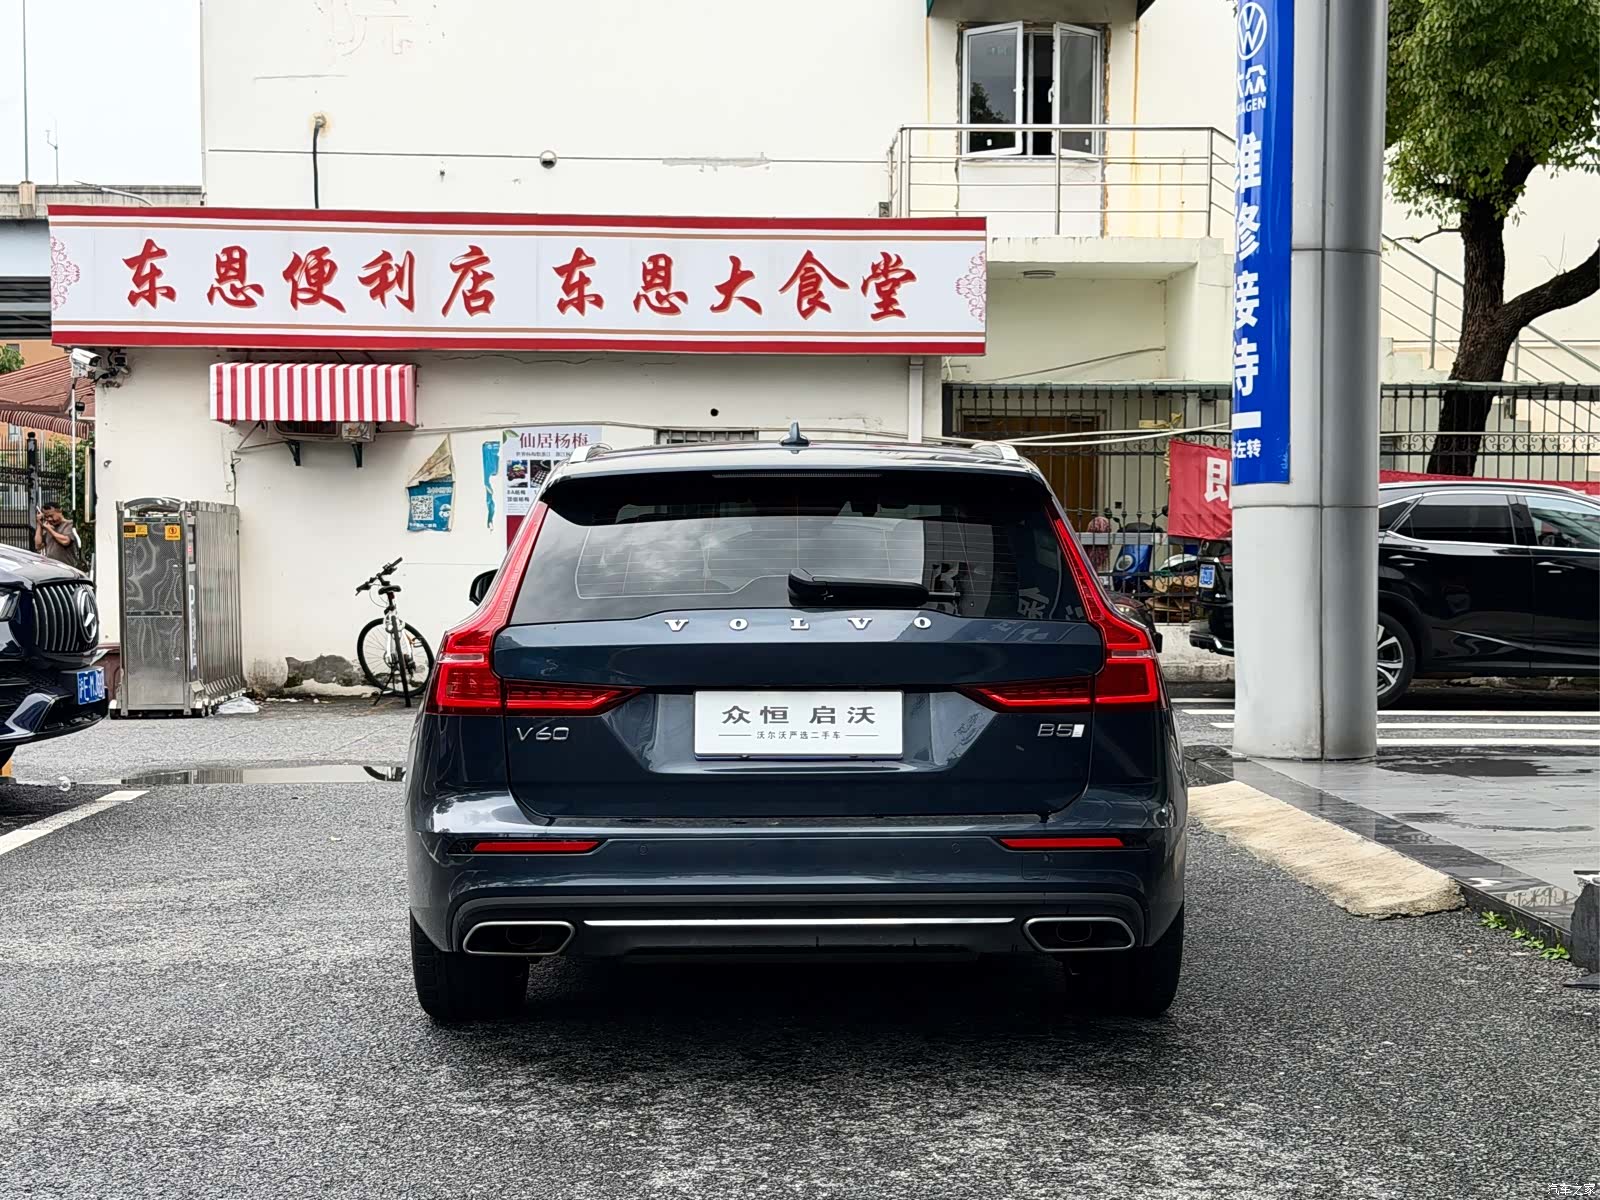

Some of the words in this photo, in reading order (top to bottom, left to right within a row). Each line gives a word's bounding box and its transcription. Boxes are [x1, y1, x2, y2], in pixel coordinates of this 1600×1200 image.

[122, 239, 497, 317] 东恩便利店
[553, 247, 917, 321] 东恩大食堂
[520, 433, 588, 448] 仙居杨梅
[664, 617, 932, 632] VOLVO
[722, 705, 790, 725] 众恒
[808, 705, 876, 725] 启沃
[516, 726, 570, 741] V60
[756, 730, 841, 740] 沃尔沃严选二手车
[1037, 723, 1073, 737] B5
